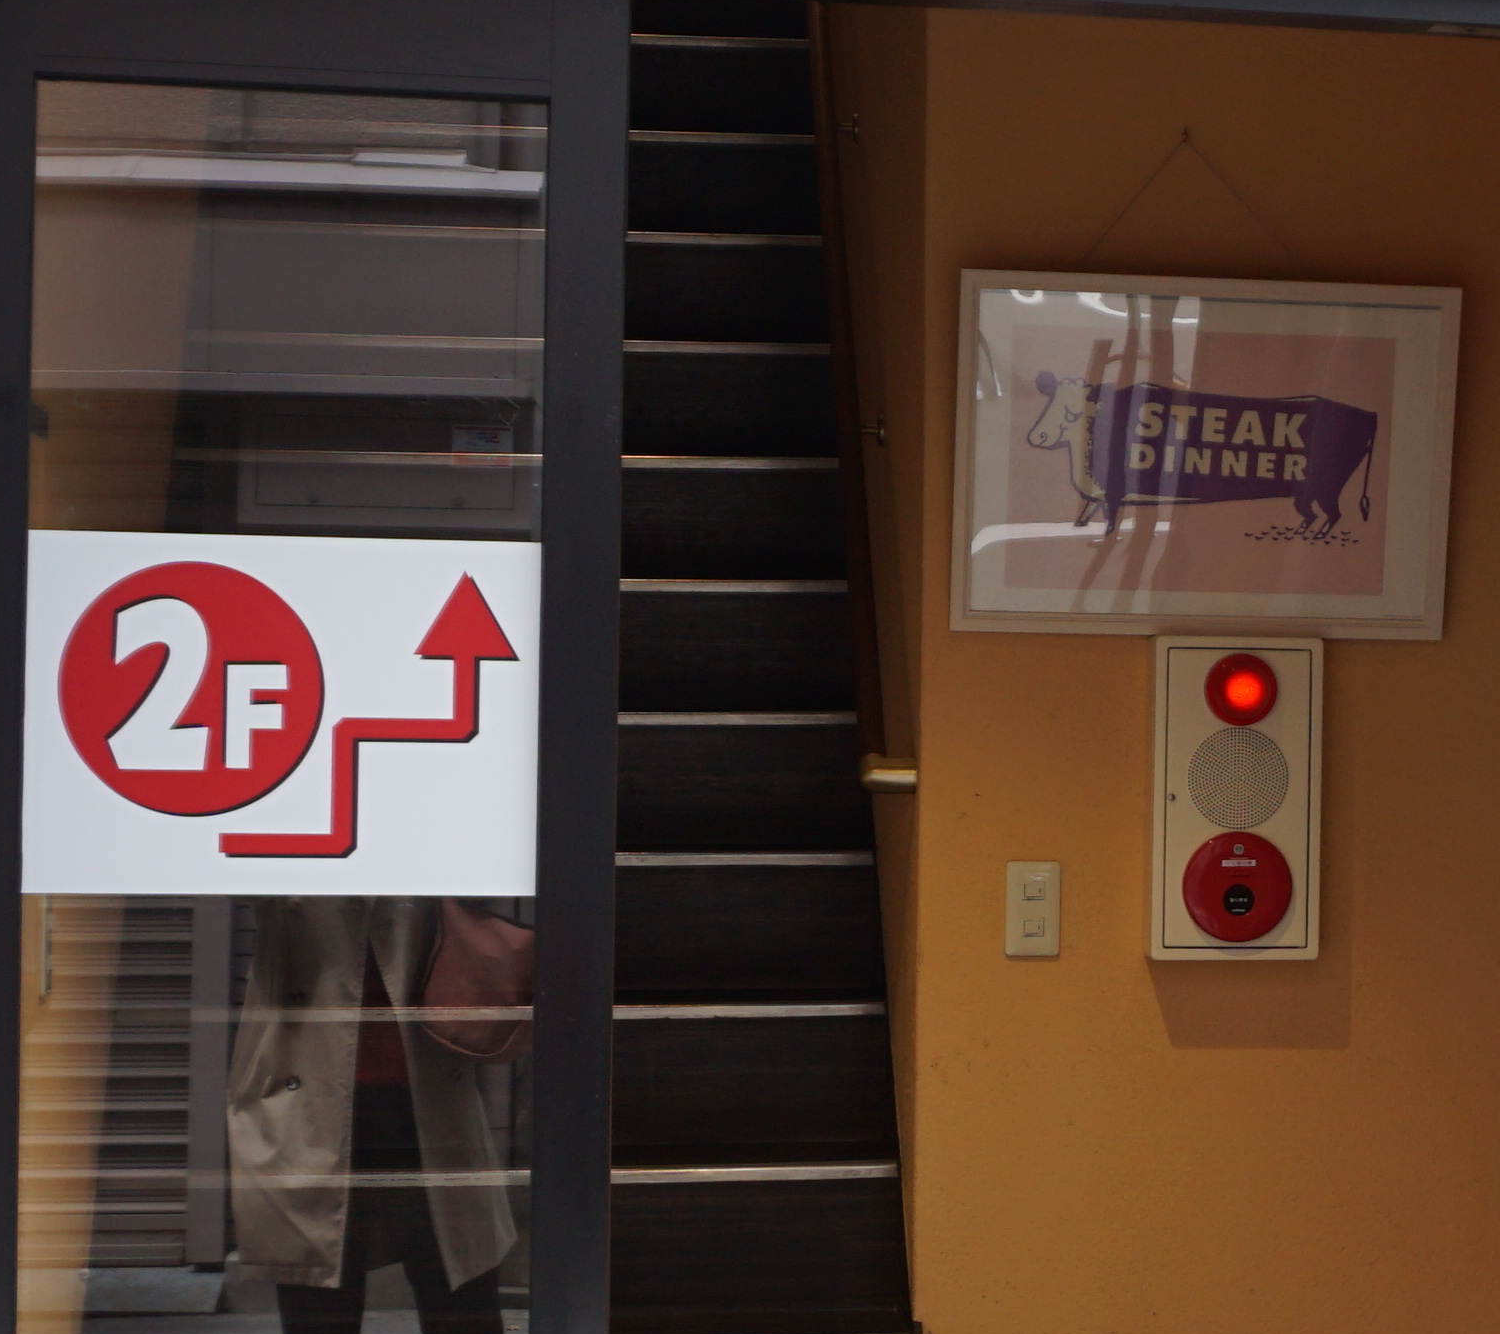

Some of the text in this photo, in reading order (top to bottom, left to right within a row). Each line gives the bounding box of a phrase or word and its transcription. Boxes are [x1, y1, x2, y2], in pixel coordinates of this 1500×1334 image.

[1134, 402, 1308, 448] STEAK
[1128, 442, 1309, 482] DINNER
[104, 594, 289, 771] 2F
